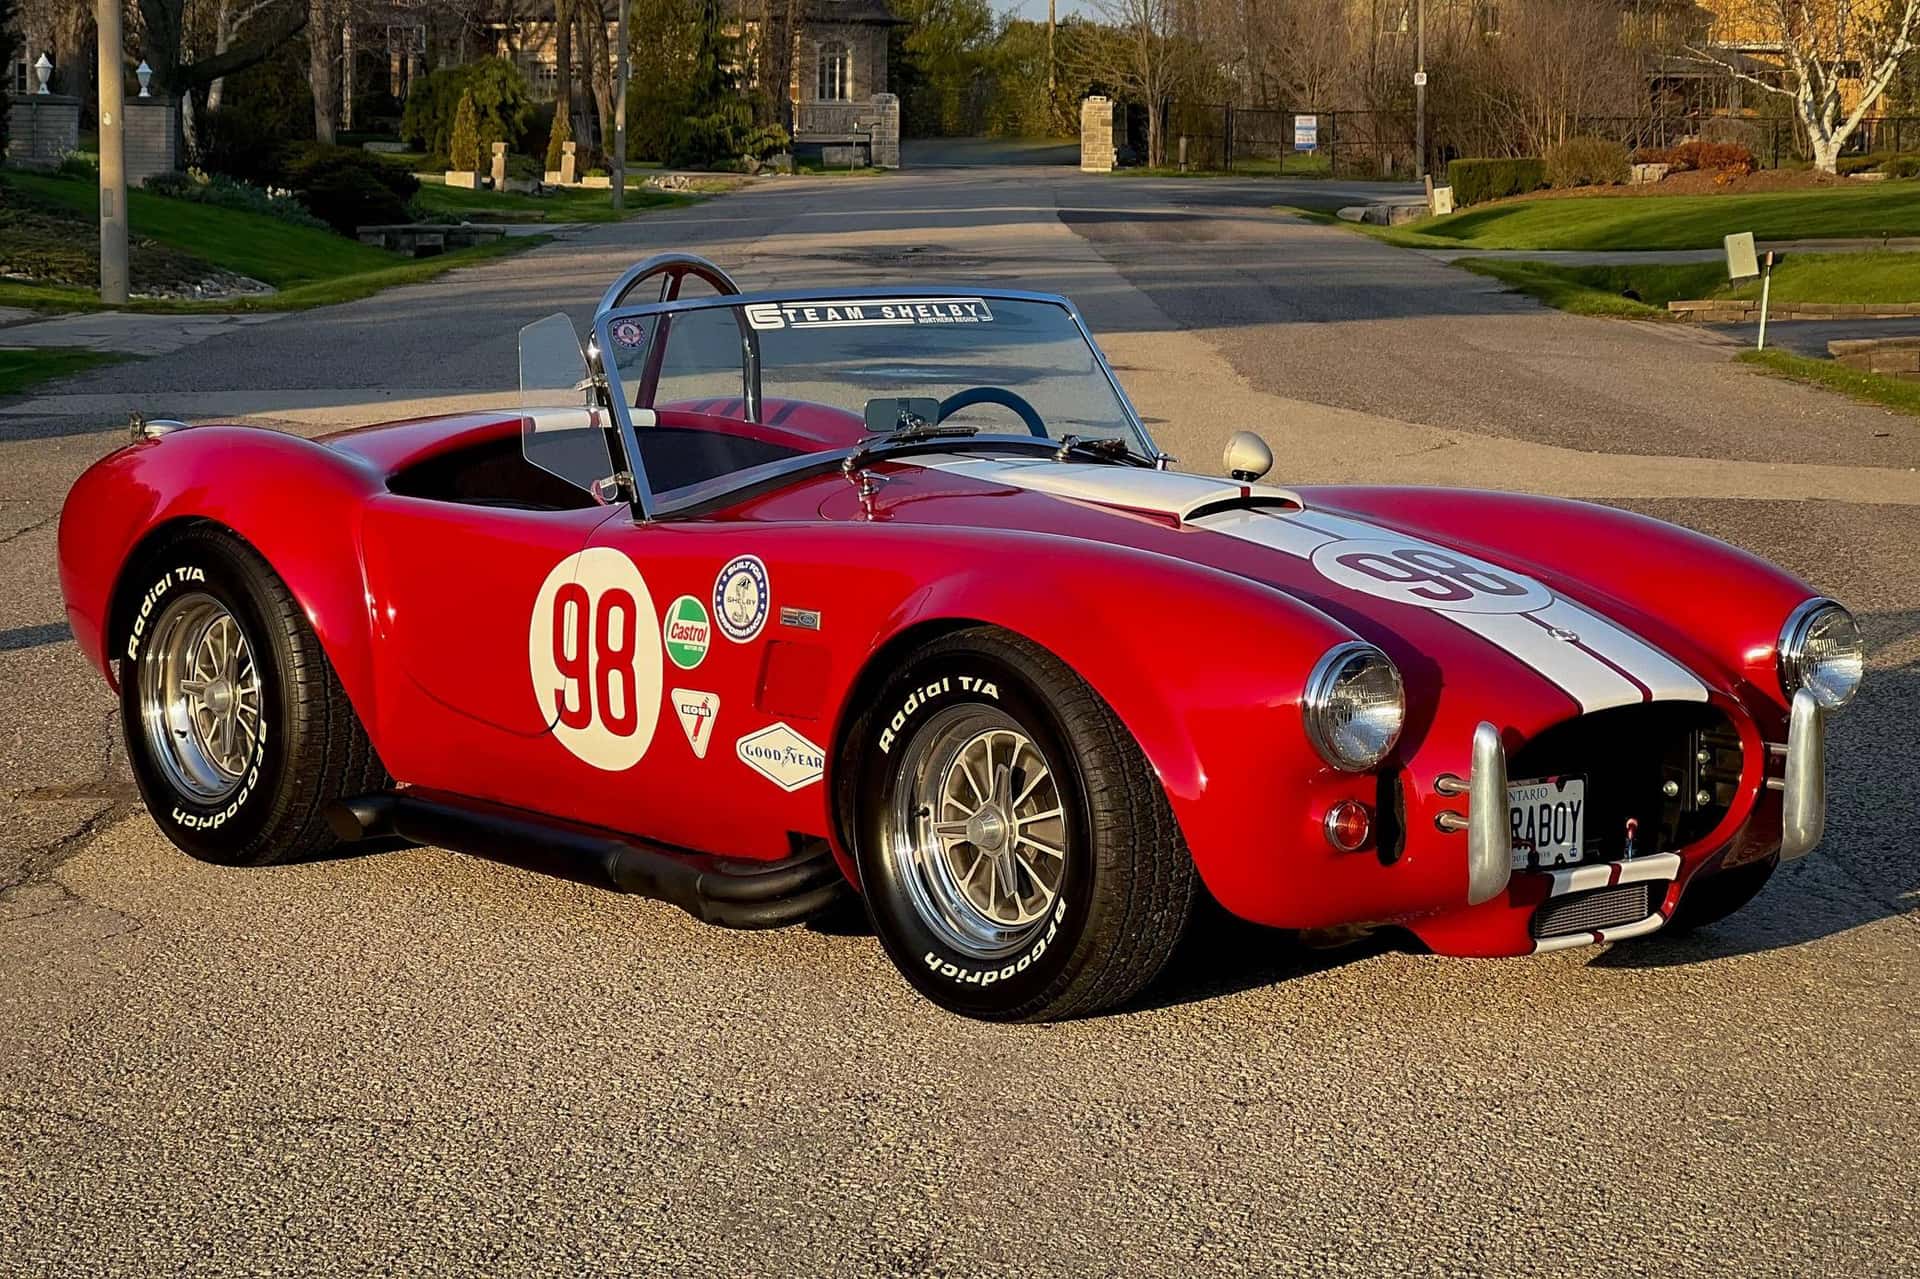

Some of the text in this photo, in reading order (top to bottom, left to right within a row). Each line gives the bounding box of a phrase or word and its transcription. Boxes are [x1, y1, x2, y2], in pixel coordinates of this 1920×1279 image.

[882, 302, 979, 319] SHELBY
[727, 561, 763, 581] BUILT FOR
[1336, 549, 1528, 601] 98
[127, 566, 206, 661] Radial T/A
[727, 596, 757, 606] SHELBY
[671, 622, 708, 643] Castrol
[717, 605, 763, 637] PERFORMANCE
[553, 582, 638, 738] 98
[682, 705, 711, 717] KONI
[879, 675, 999, 754] Radial T/A
[1508, 787, 1549, 802] NTARIO
[1510, 799, 1582, 849] RABOY
[923, 897, 1067, 987] BFGoodrich
